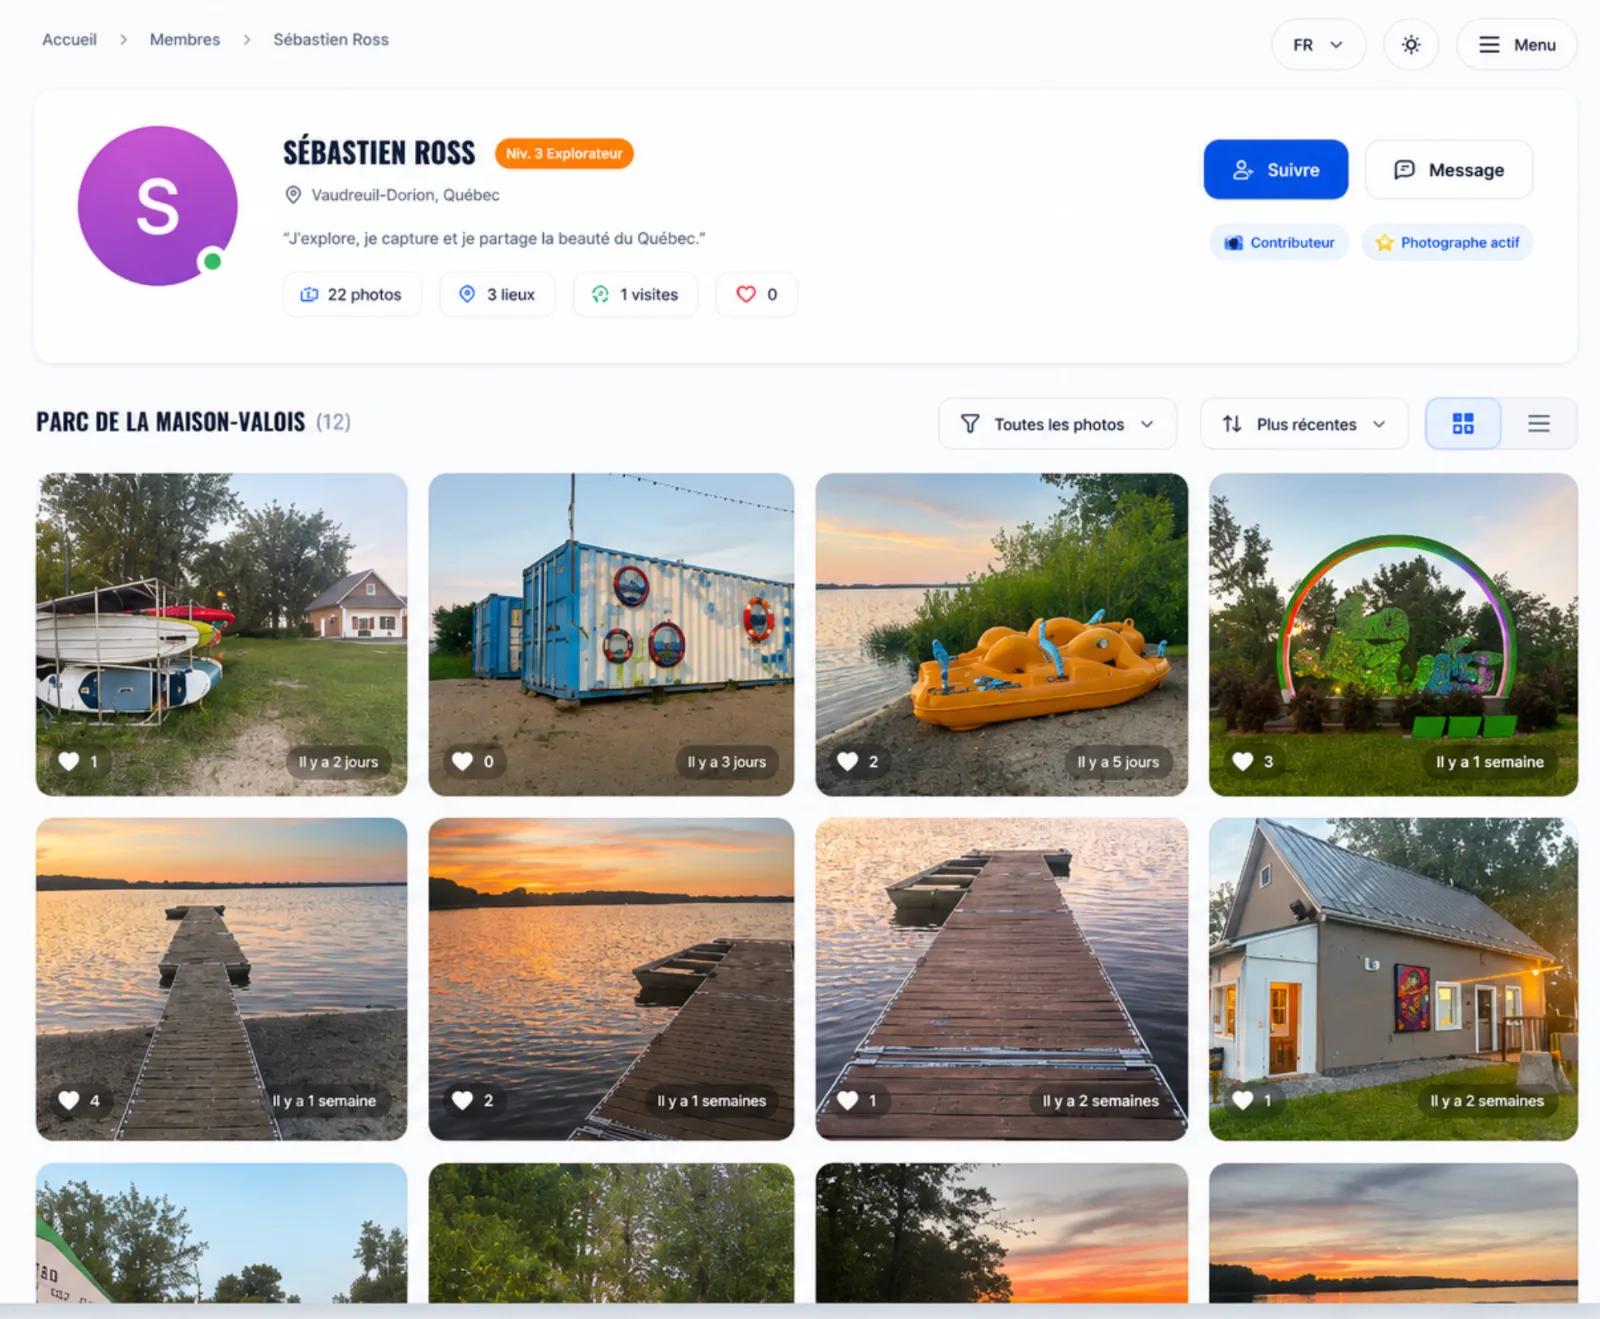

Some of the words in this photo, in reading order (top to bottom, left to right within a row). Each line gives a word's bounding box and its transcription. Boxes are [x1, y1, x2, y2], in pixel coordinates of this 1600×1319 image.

[42, 32, 97, 46] Accueil
[150, 32, 221, 46] Membres
[274, 32, 348, 46] Sébastien
[352, 32, 389, 46] Ross
[1293, 38, 1314, 52] FR
[1514, 38, 1557, 52] Menu
[283, 133, 406, 166] SÉBASTIEN
[414, 140, 476, 166] ROSS
[506, 147, 531, 160] Niv.
[534, 147, 544, 160] 3
[547, 147, 623, 163] Explorateur
[1267, 162, 1321, 178] Suivre
[1429, 162, 1505, 181] Message
[311, 188, 439, 204] Vaudreuil-Dorion,
[443, 188, 500, 203] Québec
[136, 177, 179, 236] S
[364, 231, 378, 248] je
[381, 233, 439, 248] capture
[442, 233, 458, 245] et
[461, 231, 475, 248] je
[479, 233, 538, 249] partage
[541, 231, 554, 245] la
[558, 231, 610, 245] beauté
[614, 231, 633, 245] du
[1250, 236, 1336, 249] Contributeur
[1401, 236, 1488, 252] Photographe
[1490, 236, 1520, 249] actif
[328, 287, 347, 302] 22
[350, 287, 402, 305] photos
[487, 287, 497, 302] 3
[501, 287, 535, 302] lieux
[620, 287, 627, 302] 1
[631, 287, 679, 302] visites
[767, 287, 778, 302] 0
[36, 410, 89, 433] PARC
[95, 410, 120, 433] DE
[126, 410, 150, 433] LA
[156, 410, 306, 433] MAISON-VALOIS
[315, 412, 351, 433] (12)
[994, 417, 1045, 432] Toutes
[1048, 417, 1070, 432] les
[1073, 417, 1125, 435] photos
[1257, 417, 1289, 432] Plus
[1292, 417, 1358, 432] récentes
[91, 755, 97, 768] 1
[299, 756, 307, 768] Il
[310, 758, 318, 771] y
[321, 758, 329, 768] a
[333, 756, 342, 768] 2
[345, 756, 379, 771] jours
[484, 755, 494, 768] 0
[688, 756, 695, 768] Il
[699, 758, 707, 771] y
[710, 758, 718, 768] a
[722, 756, 730, 768] 3
[734, 756, 767, 771] jours
[869, 755, 878, 768] 2
[1078, 756, 1085, 768] Il
[1089, 758, 1097, 771] y
[1101, 758, 1109, 768] a
[1113, 756, 1122, 768] 5
[1125, 756, 1160, 771] jours
[1265, 755, 1273, 768] 3
[1437, 756, 1444, 768] Il
[1448, 758, 1456, 771] y
[1461, 758, 1469, 768] a
[1474, 756, 1479, 768] 1
[1485, 756, 1544, 768] semaine
[90, 1095, 100, 1107] 4
[273, 1095, 280, 1107] Il
[284, 1097, 292, 1110] y
[296, 1097, 304, 1107] a
[308, 1095, 314, 1107] 1
[319, 1095, 376, 1107] semaine
[484, 1094, 493, 1107] 2
[658, 1095, 665, 1107] Il
[669, 1097, 677, 1110] y
[680, 1097, 688, 1107] a
[692, 1095, 698, 1107] 1
[702, 1095, 767, 1107] semaines
[870, 1094, 876, 1107] 1
[1043, 1095, 1051, 1107] Il
[1054, 1097, 1063, 1110] y
[1066, 1097, 1075, 1107] a
[1079, 1094, 1088, 1107] 2
[1092, 1094, 1159, 1107] semaines
[1264, 1094, 1271, 1107] 1
[1431, 1095, 1438, 1107] Il
[1442, 1097, 1449, 1110] y
[1454, 1097, 1462, 1107] a
[1466, 1095, 1474, 1107] 2
[1478, 1095, 1545, 1107] semaines
